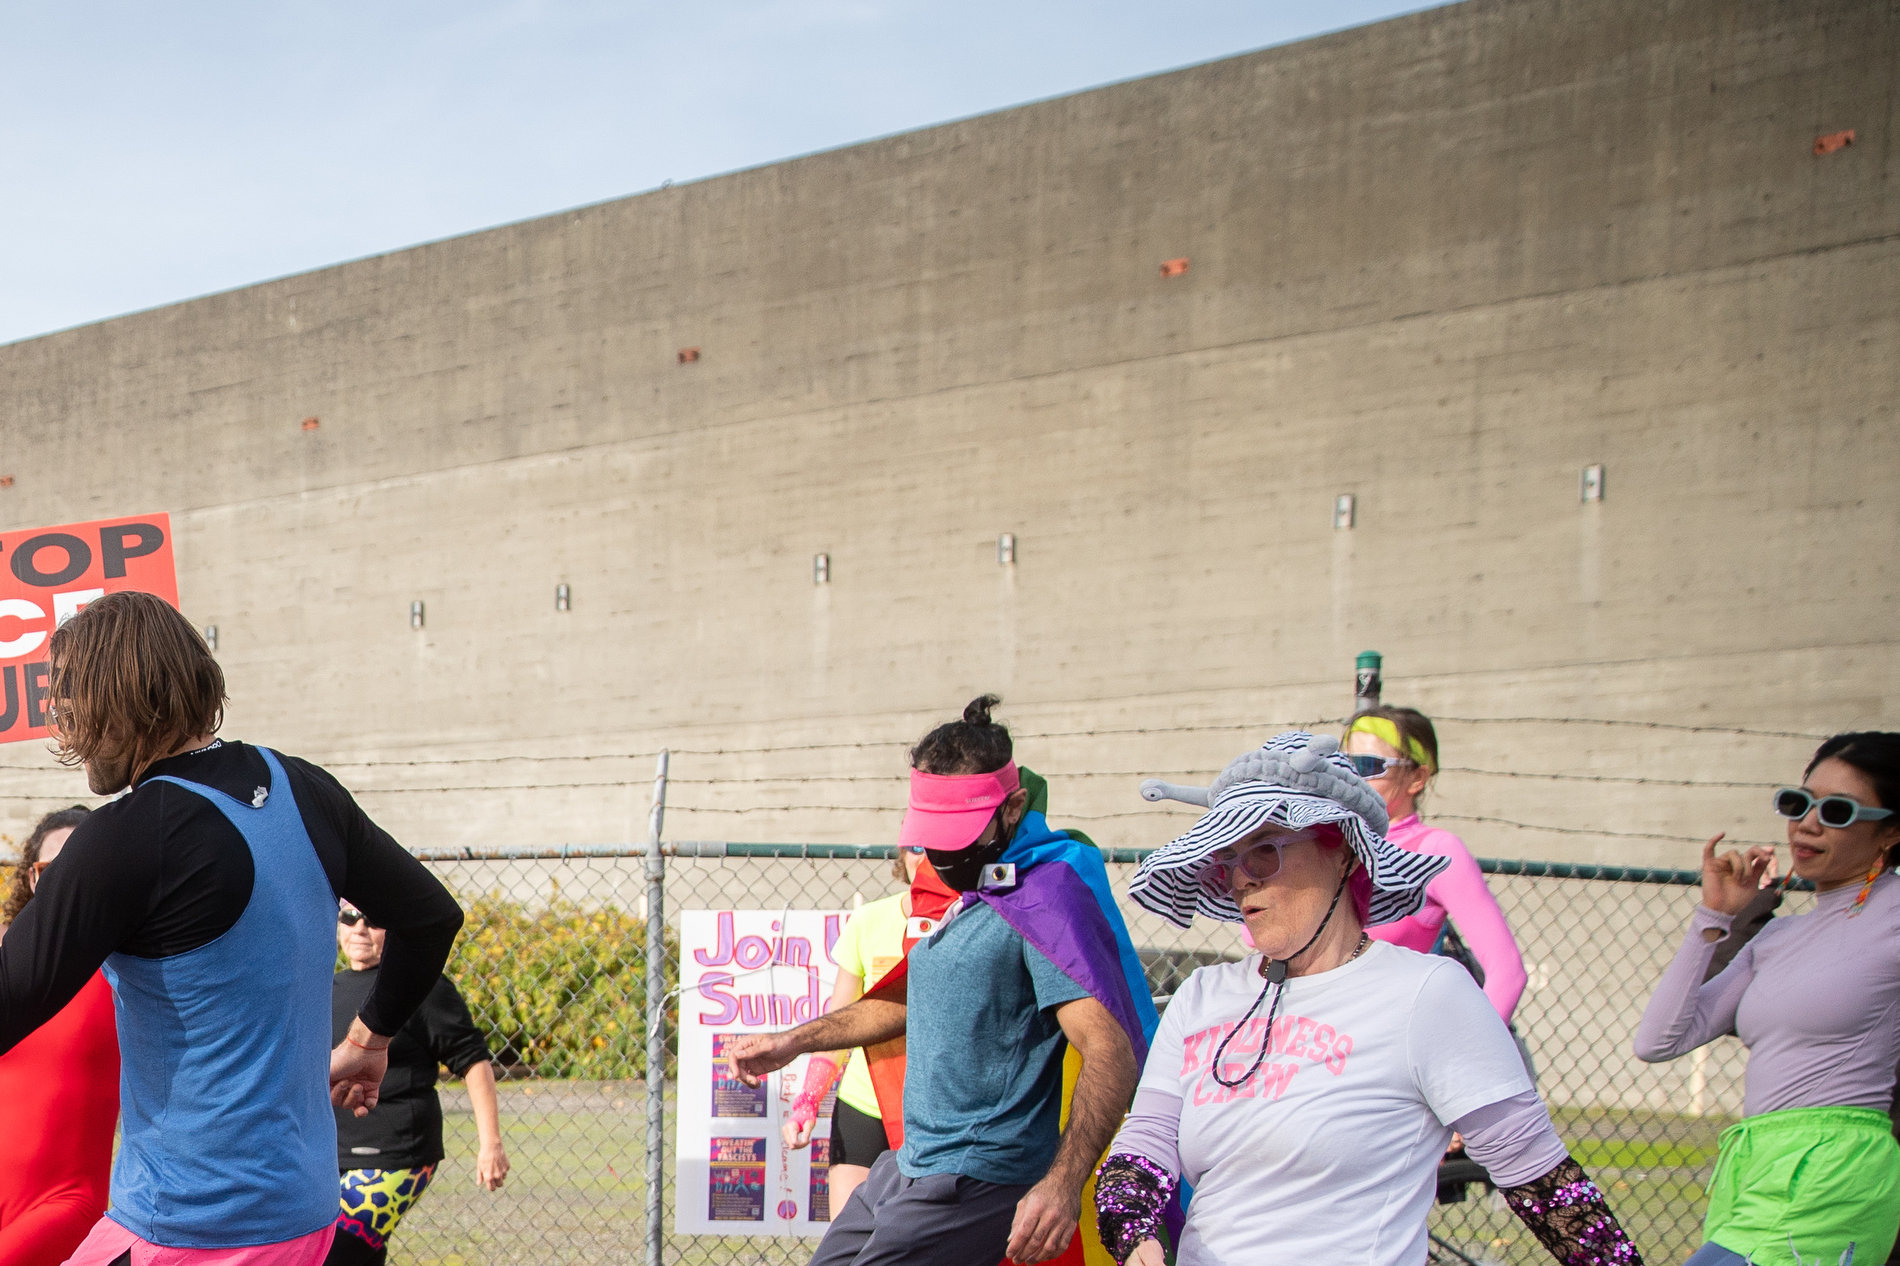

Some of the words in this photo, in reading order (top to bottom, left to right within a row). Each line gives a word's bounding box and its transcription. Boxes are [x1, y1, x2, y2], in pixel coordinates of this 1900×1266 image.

[694, 911, 812, 969] Join
[698, 966, 833, 1026] Sund
[1180, 1015, 1353, 1076] KINDNESS
[1193, 1063, 1299, 1107] CREW
